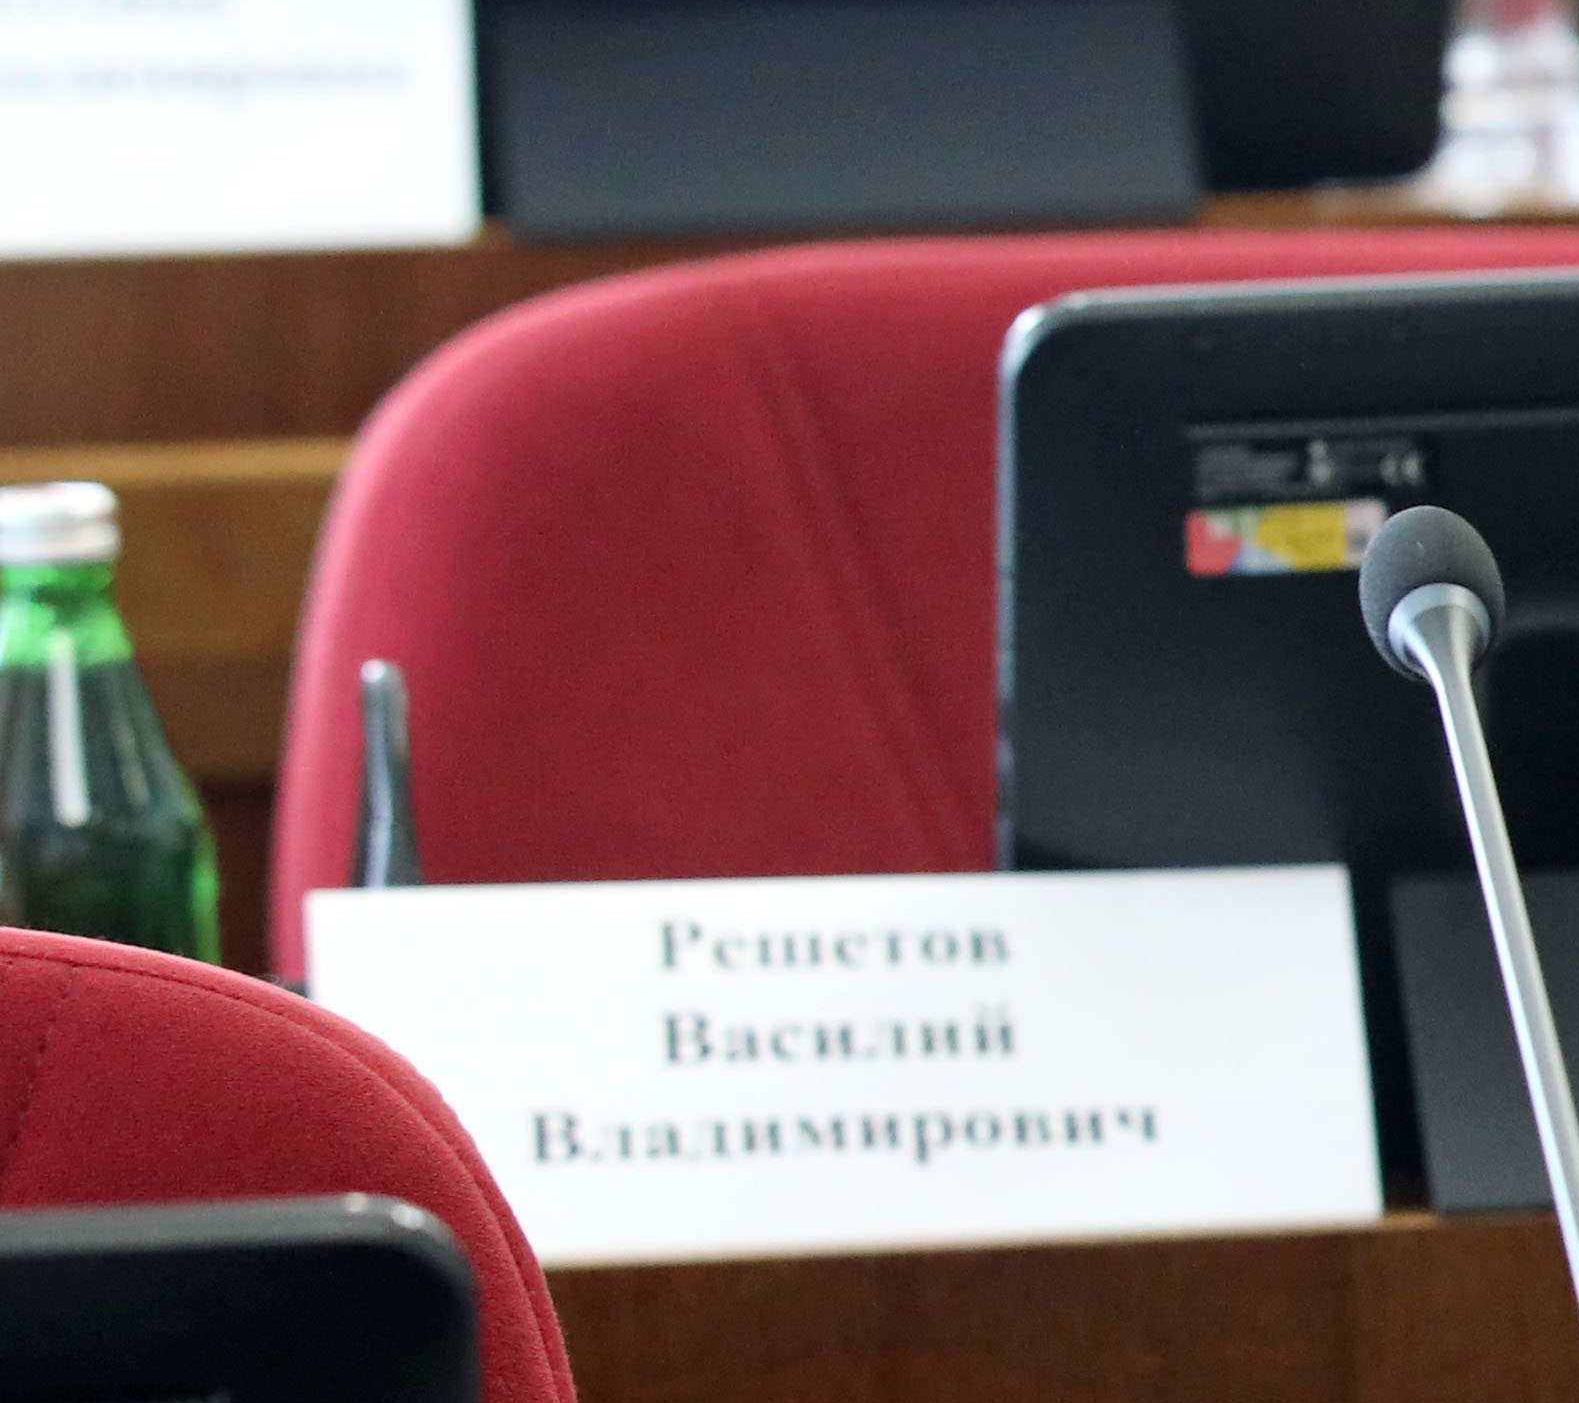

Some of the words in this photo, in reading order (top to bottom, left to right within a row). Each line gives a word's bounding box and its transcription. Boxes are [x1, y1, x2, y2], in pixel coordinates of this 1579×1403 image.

[657, 916, 1014, 974] Решетов
[659, 1004, 1019, 1068] Василий
[529, 1100, 1163, 1169] Владимирович
